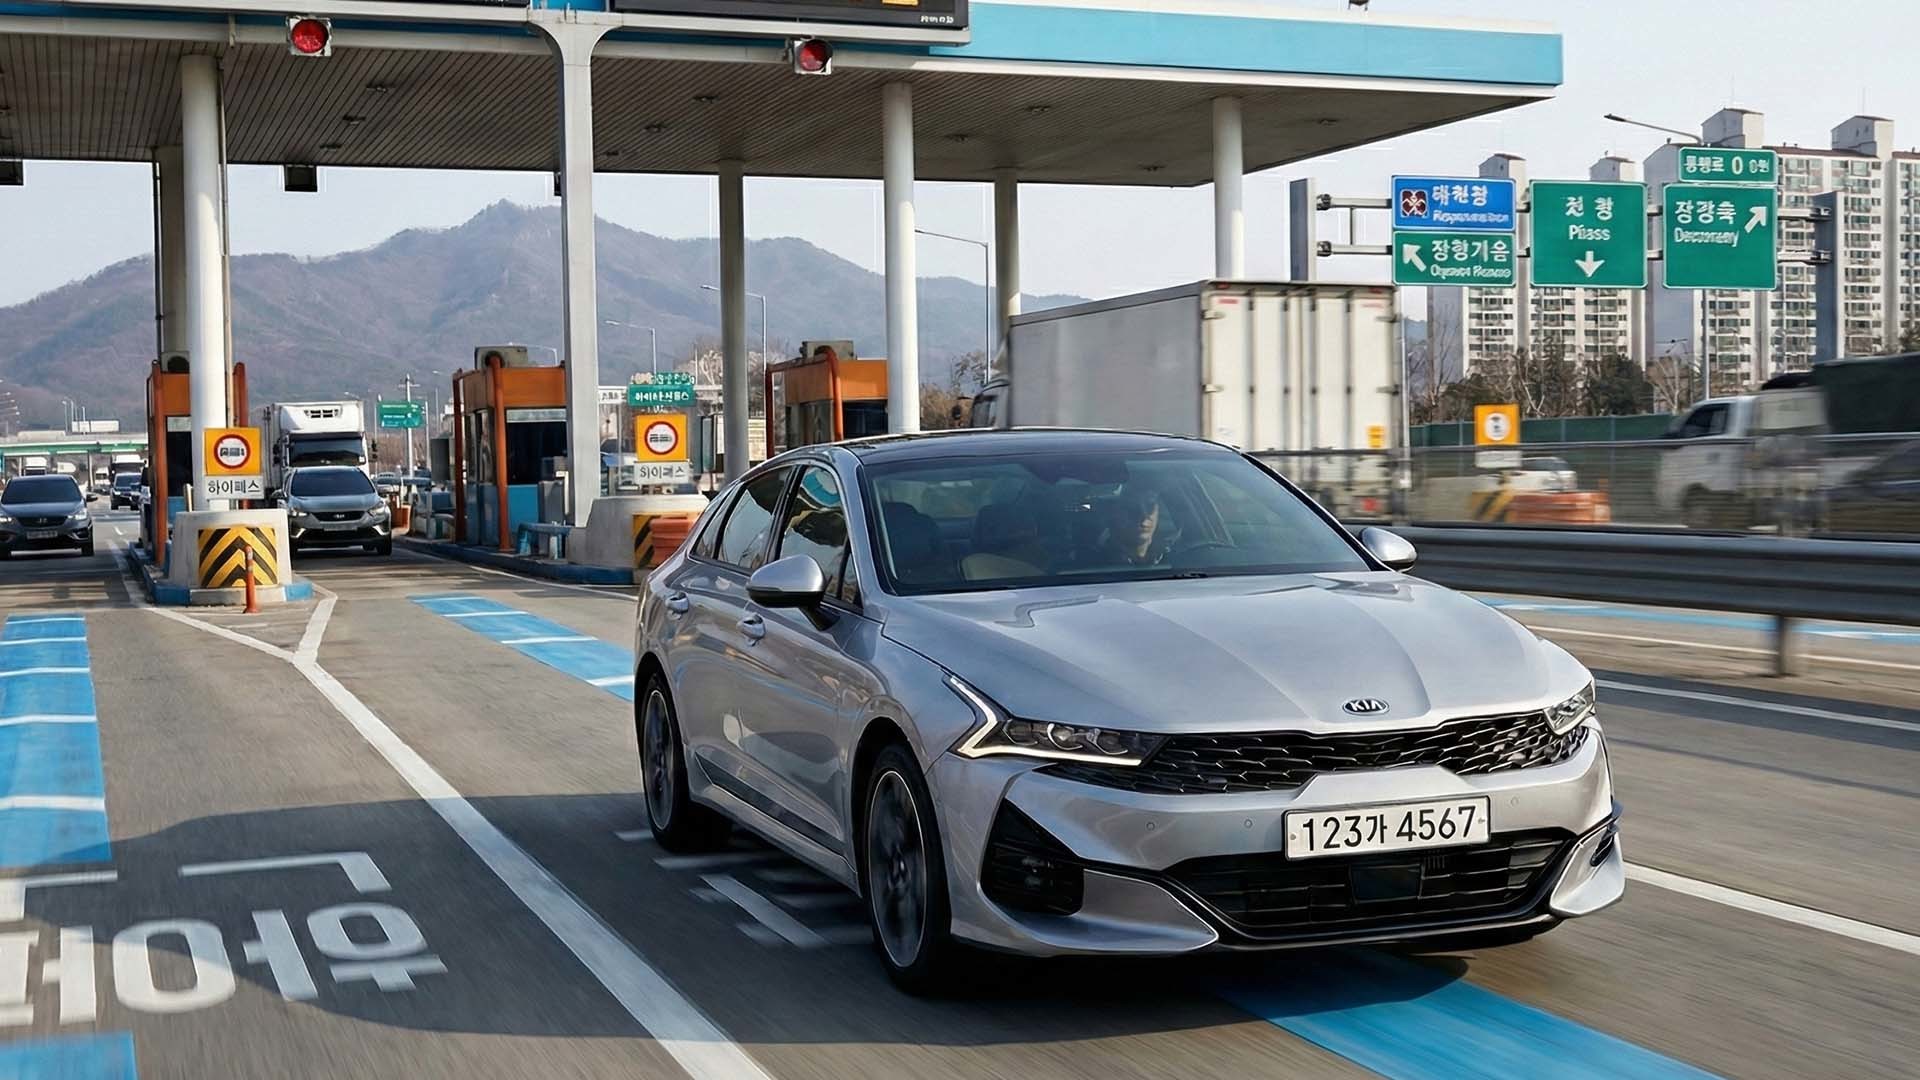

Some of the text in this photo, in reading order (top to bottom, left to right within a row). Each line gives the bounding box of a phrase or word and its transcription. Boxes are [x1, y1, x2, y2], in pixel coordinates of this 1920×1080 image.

[1350, 699, 1383, 711] KIA
[1302, 805, 1477, 852] 123가 4567
